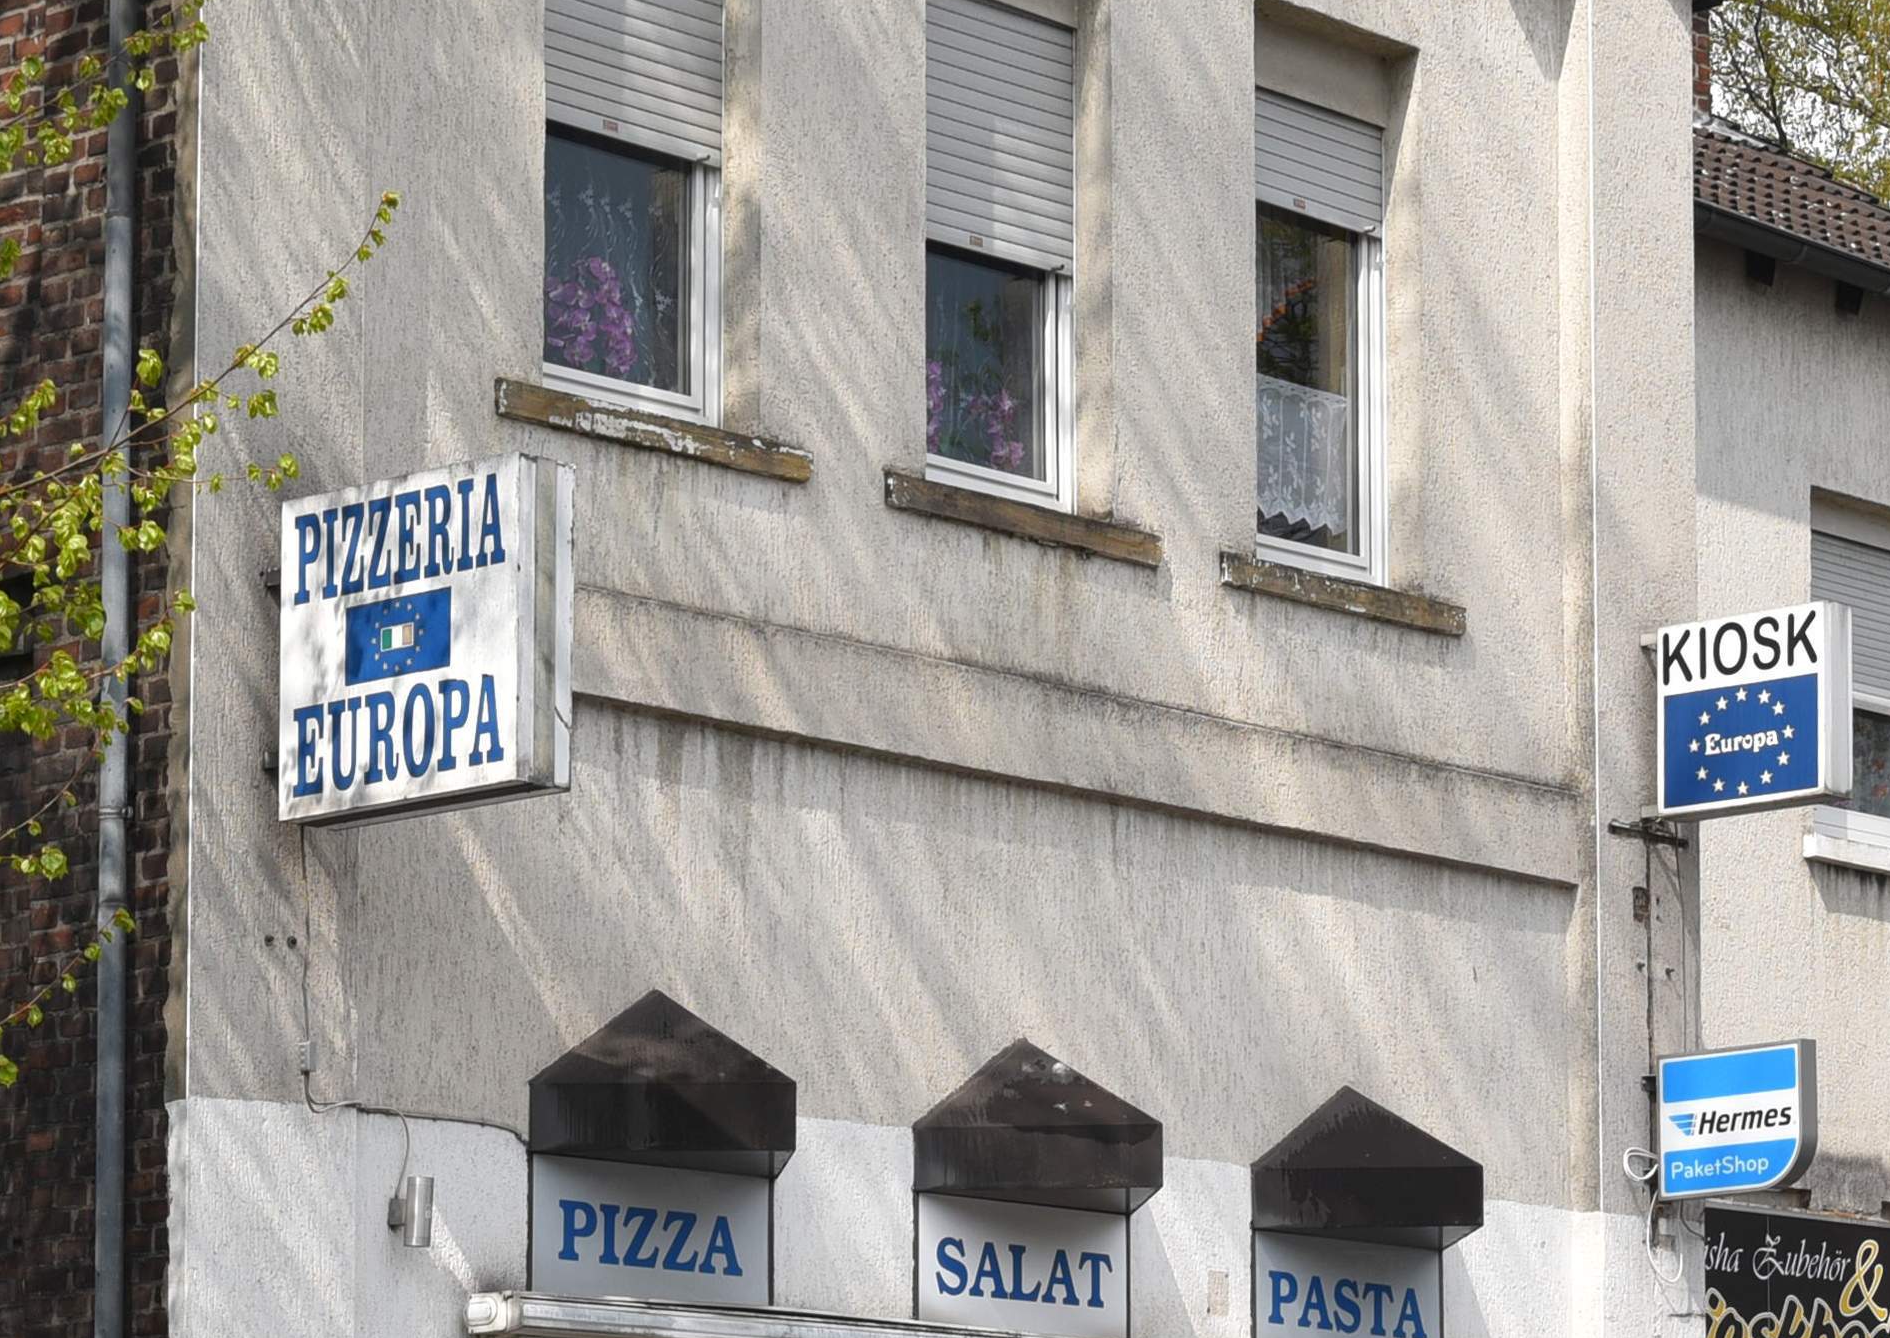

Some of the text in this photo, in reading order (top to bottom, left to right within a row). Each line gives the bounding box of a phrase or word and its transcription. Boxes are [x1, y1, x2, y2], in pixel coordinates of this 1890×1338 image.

[294, 473, 506, 605] PIZZERIA
[1663, 610, 1818, 686] KIOSK
[293, 674, 504, 798] EUROPA
[1704, 728, 1779, 756] Europa
[1698, 1105, 1792, 1136] Hermes
[1671, 1155, 1769, 1180] PaketShop
[558, 1199, 743, 1277] PIZZA
[935, 1237, 1113, 1308] SALAT
[1704, 1232, 1887, 1321] isha Zubehör &
